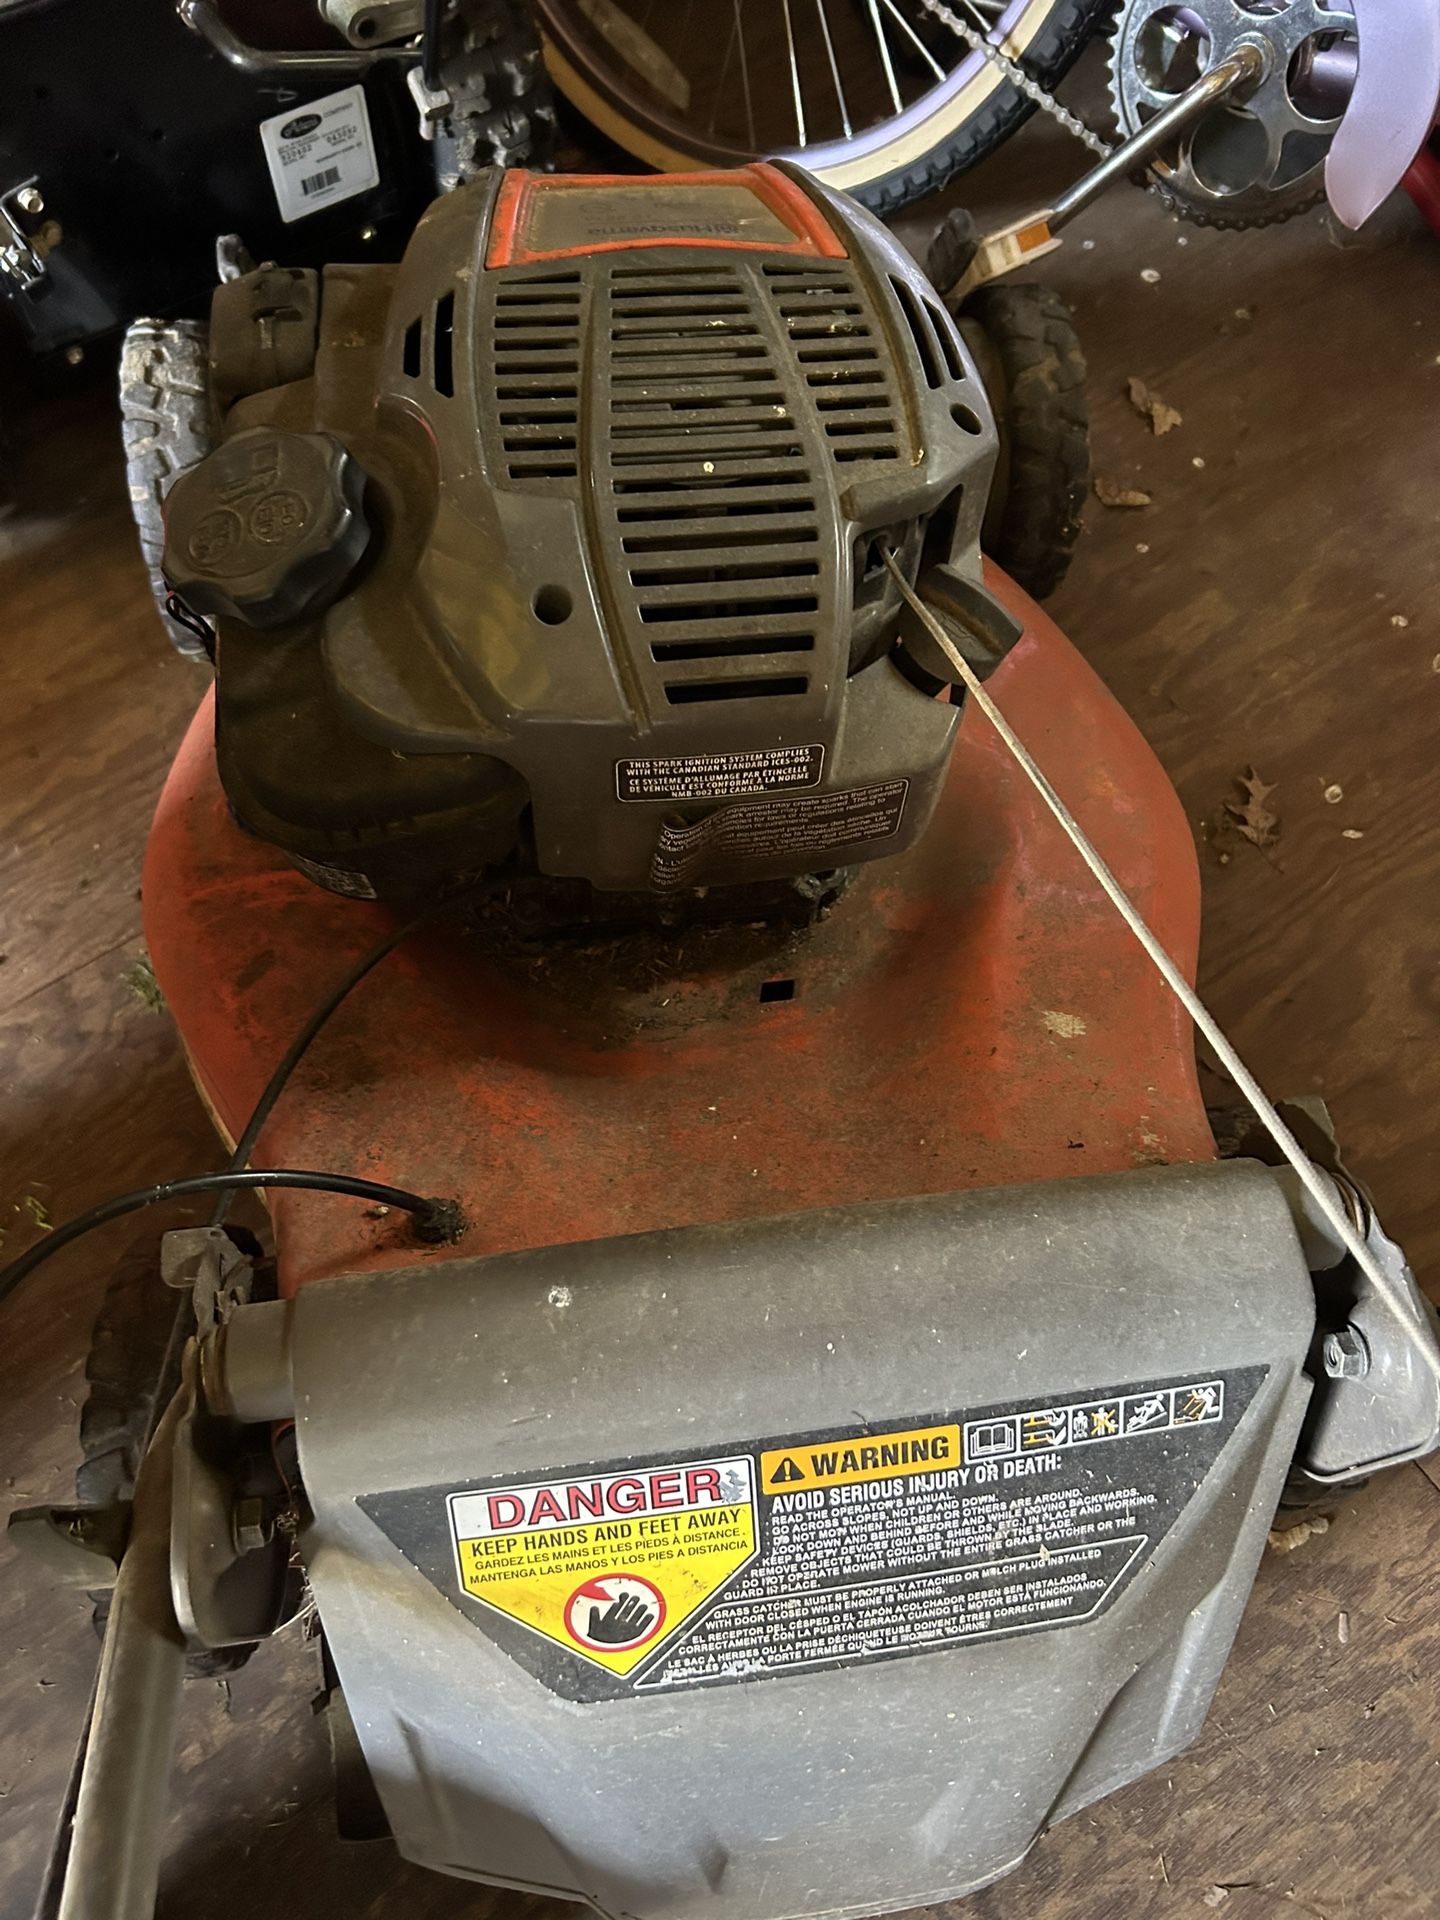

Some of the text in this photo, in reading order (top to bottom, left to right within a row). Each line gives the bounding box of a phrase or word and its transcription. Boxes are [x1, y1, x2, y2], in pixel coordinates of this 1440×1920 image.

[629, 748, 808, 768] THIS SPARK IGNITION SYSTEM COMPLIES
[673, 764, 719, 773] CANADIAN
[722, 759, 768, 770] STANDARD
[684, 772, 739, 782] D'ALLUMAGE
[742, 770, 759, 778] PAR
[707, 778, 753, 788] CONFORME
[778, 772, 808, 782] NORME
[730, 785, 767, 793] CANADA.
[811, 1436, 948, 1476] WARNING
[487, 1468, 722, 1530] DANGER
[771, 1453, 1061, 1514] AVOID SERIOUS INJURY OR DEATH:
[762, 1493, 1156, 1567] KEEP IN AND WORKING.
[772, 1490, 955, 1525] READ THE MANUAL.
[772, 1493, 998, 1536] GO ACROSS NOT UP AND DOWN.
[772, 1487, 1139, 1556] LOOK DOWN AND BEHIND AND WHILE BACKWARDS.
[792, 1488, 1082, 1542] NOT WHEN CHILDREN OR OTHERS ARE AROUND.
[472, 1508, 740, 1557] KEEP HANDS AND FEET AWAY
[475, 1534, 680, 1570] GARDEZ LES MAINS ET LES PIEDS À
[742, 1516, 1135, 1588] DO MOWER WITHOUT THE ENTIRE GRASS CATCHER OR THE
[750, 1525, 1032, 1578] REMOVE OBJECTS THAT COULD BE THROWN THE
[470, 1541, 747, 1584] MANTENGA LAS MANOS Y LOS PIES A DISTANCIA
[713, 1548, 1101, 1620] GRASS MUST BE PROPERLY ATTACHED OR PLUG INSTALLED
[692, 1634, 704, 1644] EL
[708, 1625, 763, 1642] RECEPTOR
[766, 1622, 786, 1633] DEL
[832, 1614, 840, 1622] O
[843, 1612, 855, 1621] EL
[895, 1594, 965, 1613] ACOLCHADOR
[967, 1588, 1000, 1600] DEBEN
[1004, 1584, 1022, 1594] SER
[1026, 1572, 1086, 1590] INSTALADOS
[705, 1585, 945, 1630] WITH DOOR CLOSED WHEN ENGINE IS RUNNING.
[723, 1578, 820, 1601] GUARD PLACE.
[668, 1659, 680, 1668] LE
[684, 1655, 705, 1666] SAC
[708, 1653, 715, 1662] À
[718, 1647, 758, 1661] HERBES
[762, 1645, 776, 1654] OU
[780, 1643, 792, 1652] LA
[796, 1638, 824, 1649] PRISE
[914, 1616, 956, 1631] DOIVENT
[993, 1596, 1072, 1617] CORRECTEMENT
[679, 1634, 769, 1655] CORRECTAMENTE
[773, 1630, 794, 1641] CON
[797, 1628, 810, 1637] LA
[813, 1622, 853, 1635] PUERTA
[856, 1614, 904, 1628] CERRADA
[907, 1606, 949, 1620] CUANDO
[953, 1603, 964, 1612] EL
[967, 1596, 1002, 1610] MOTOR
[1033, 1578, 1106, 1598] FUNCIONANDO.
[767, 1650, 801, 1663] PORTE
[886, 1635, 897, 1644] LE
